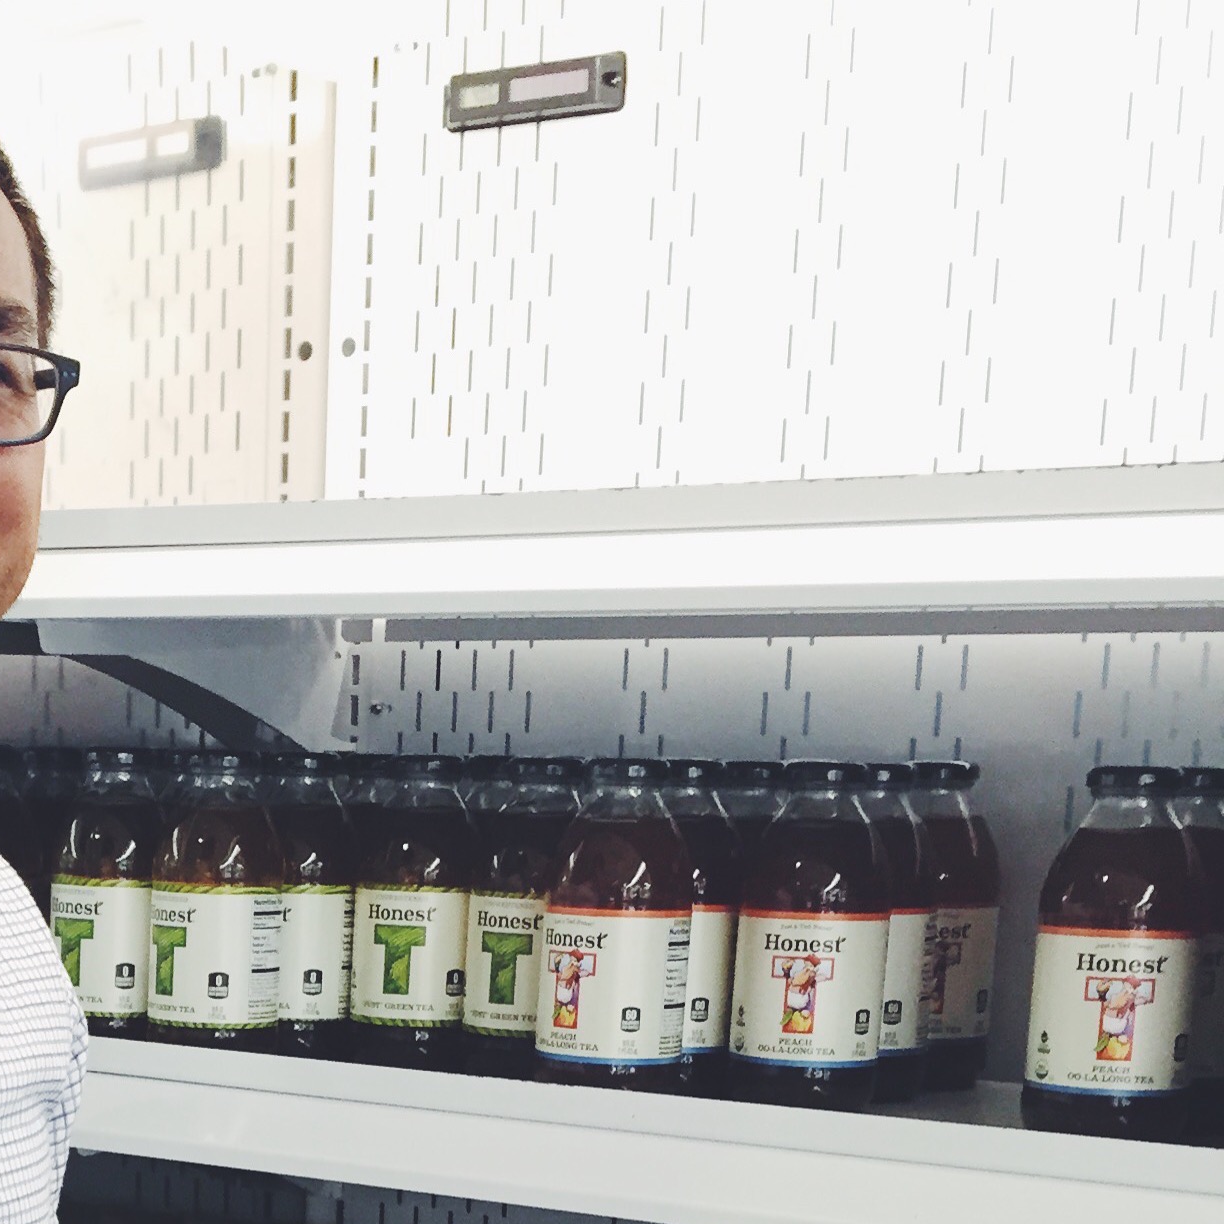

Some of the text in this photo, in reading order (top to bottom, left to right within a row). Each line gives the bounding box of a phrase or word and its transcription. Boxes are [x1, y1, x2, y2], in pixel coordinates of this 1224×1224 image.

[367, 903, 437, 923] Honest
[477, 910, 544, 931] Honest
[545, 927, 609, 950] Honest
[764, 932, 847, 953] Honest
[1075, 952, 1169, 974] Honest
[778, 1036, 813, 1047] PEACH
[815, 1046, 836, 1057] TEA
[1091, 1064, 1131, 1075] PEACH
[1133, 1075, 1155, 1085] TEA
